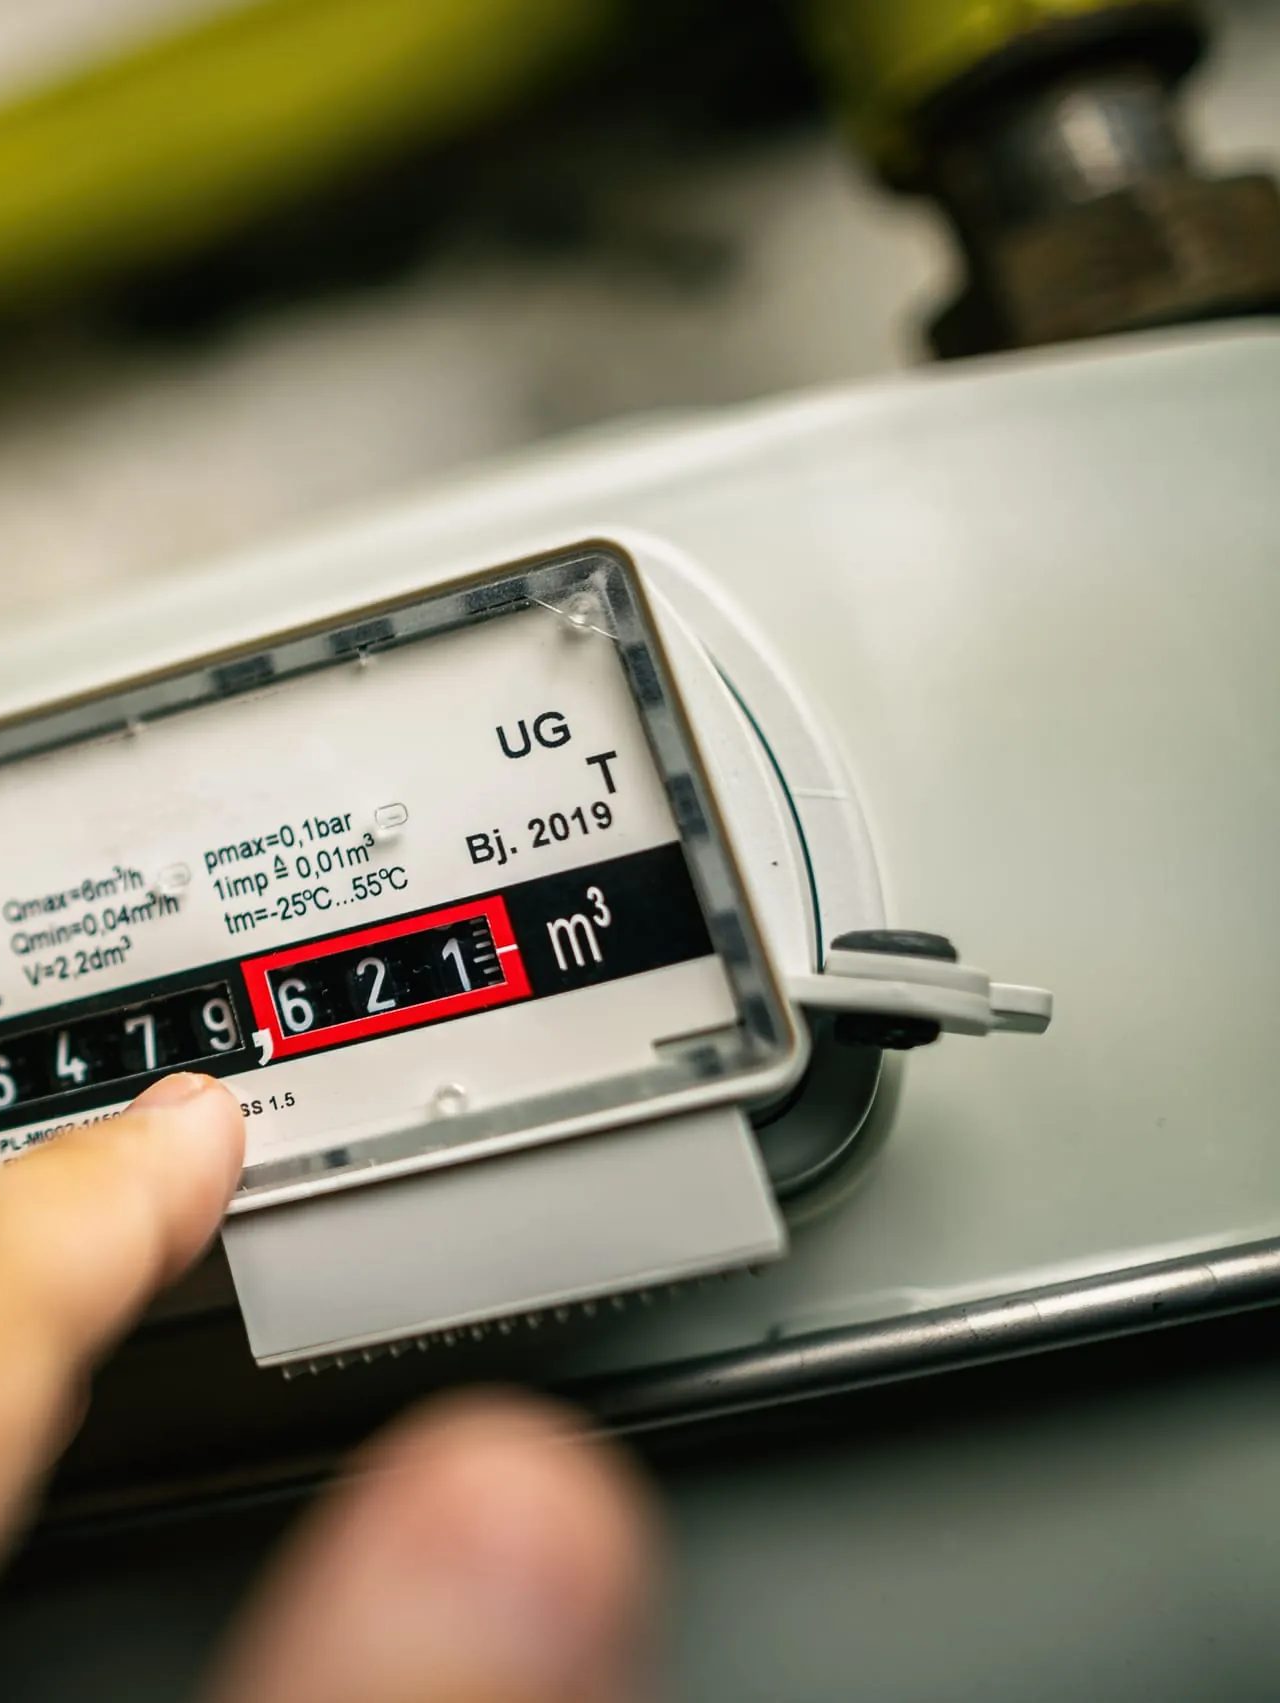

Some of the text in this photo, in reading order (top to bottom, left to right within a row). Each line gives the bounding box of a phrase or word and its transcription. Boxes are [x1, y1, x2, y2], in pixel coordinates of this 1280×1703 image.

[496, 711, 572, 759] UG
[585, 750, 618, 794] T
[204, 812, 352, 874] pmax=0,1bar
[465, 801, 613, 866] Bj. 2019
[213, 870, 269, 901] 1imp
[269, 1091, 296, 1111] 1.5
